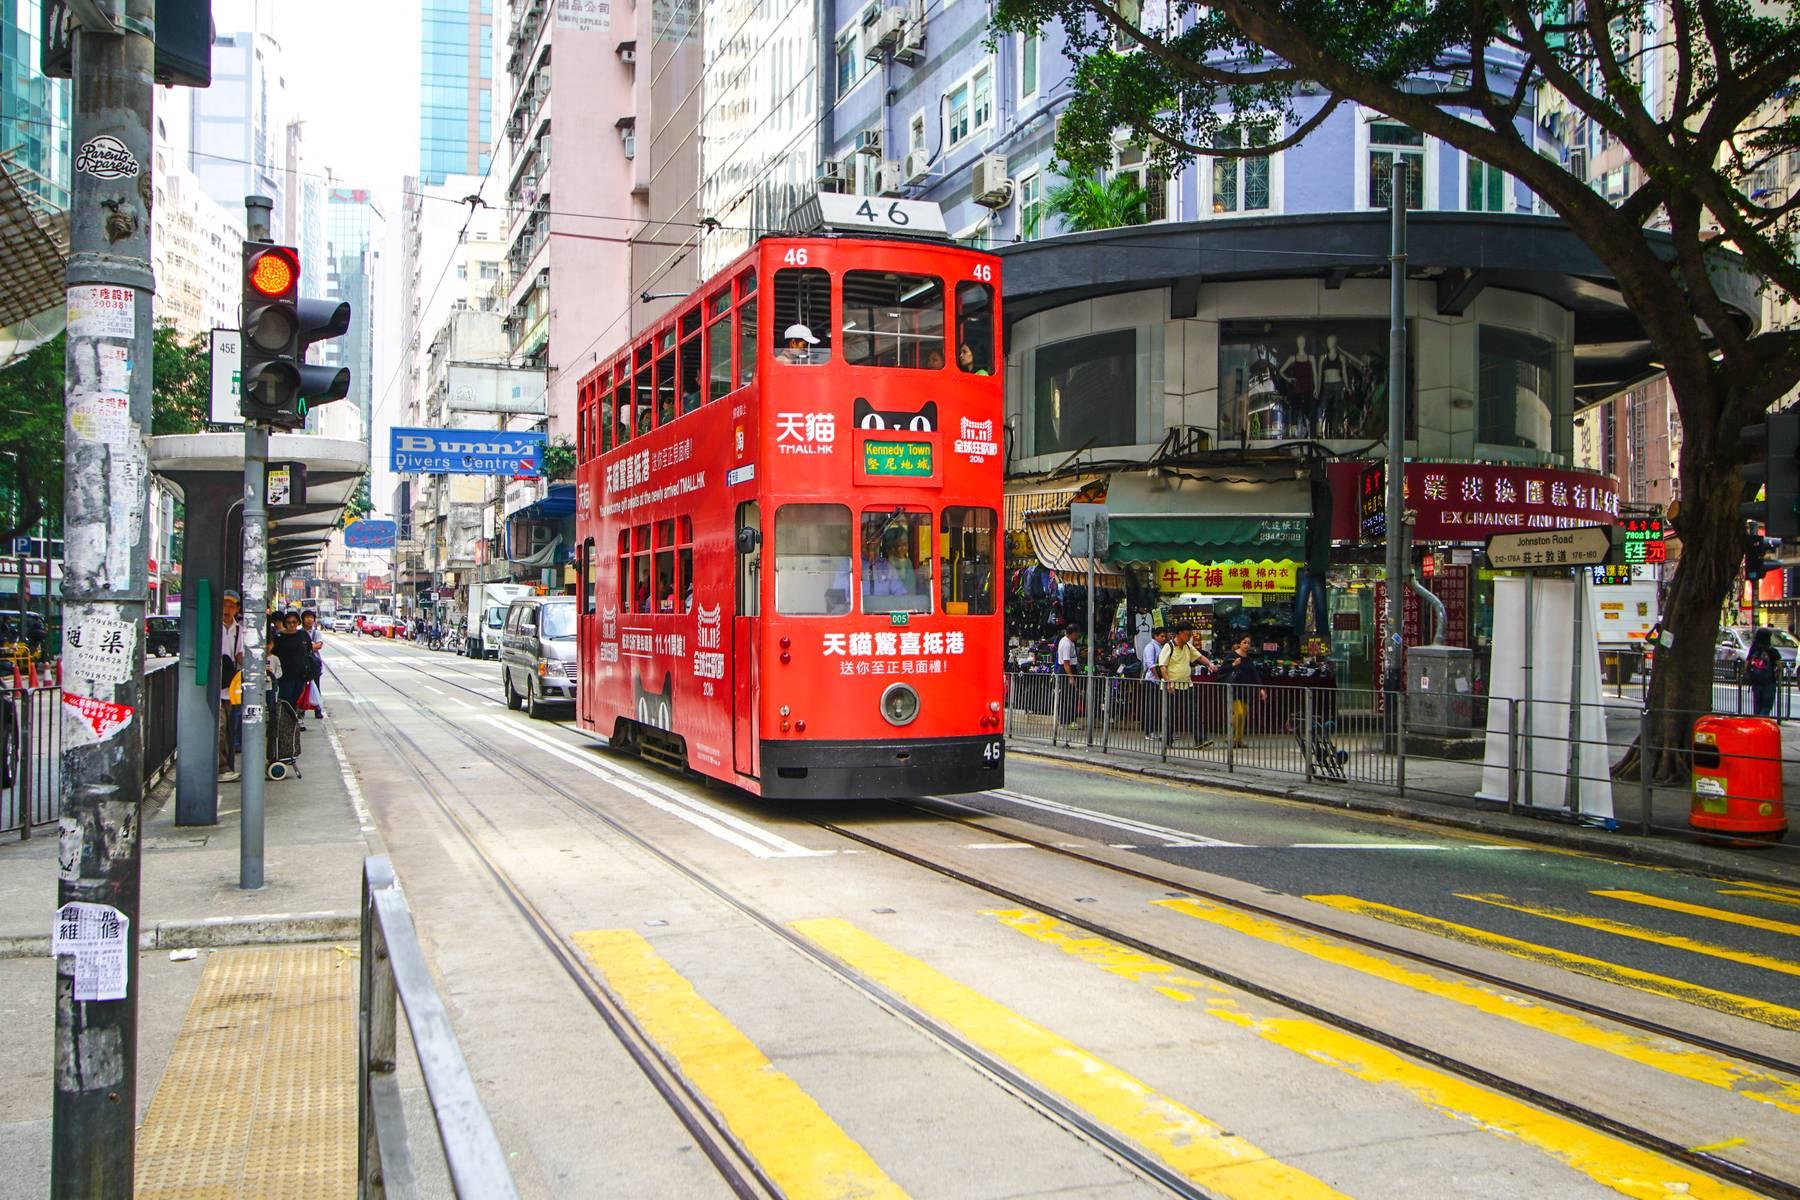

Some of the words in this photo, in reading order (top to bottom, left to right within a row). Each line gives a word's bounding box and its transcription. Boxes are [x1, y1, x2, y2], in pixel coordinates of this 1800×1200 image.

[89, 160, 138, 176] parents
[856, 199, 909, 226] 46
[784, 248, 808, 265] 46
[973, 264, 991, 281] 46
[220, 343, 236, 354] 45E
[776, 413, 835, 442] 天貓
[396, 436, 534, 456] Bunn's
[778, 445, 833, 454] TMALL.HK
[866, 443, 905, 457] Kennedy
[907, 443, 931, 456] Town
[396, 454, 450, 468] Divers
[461, 456, 519, 469] Centre
[969, 455, 984, 464] 2016
[664, 480, 679, 499] arrived
[680, 471, 705, 494] TMALL.HK
[1441, 511, 1525, 526] EXCHANGE
[1528, 514, 1552, 528] AND
[17, 538, 28, 551] P
[1517, 535, 1550, 547] Johnston
[1552, 534, 1574, 544] Road
[1163, 567, 1223, 588] 牛仔褲
[892, 614, 906, 624] 005
[823, 631, 965, 655] 天貓驚喜抵港
[79, 653, 121, 665] 67918528
[840, 660, 947, 675] 送你至正見面禮!
[75, 670, 118, 681] 67918528
[984, 742, 1001, 760] 46
